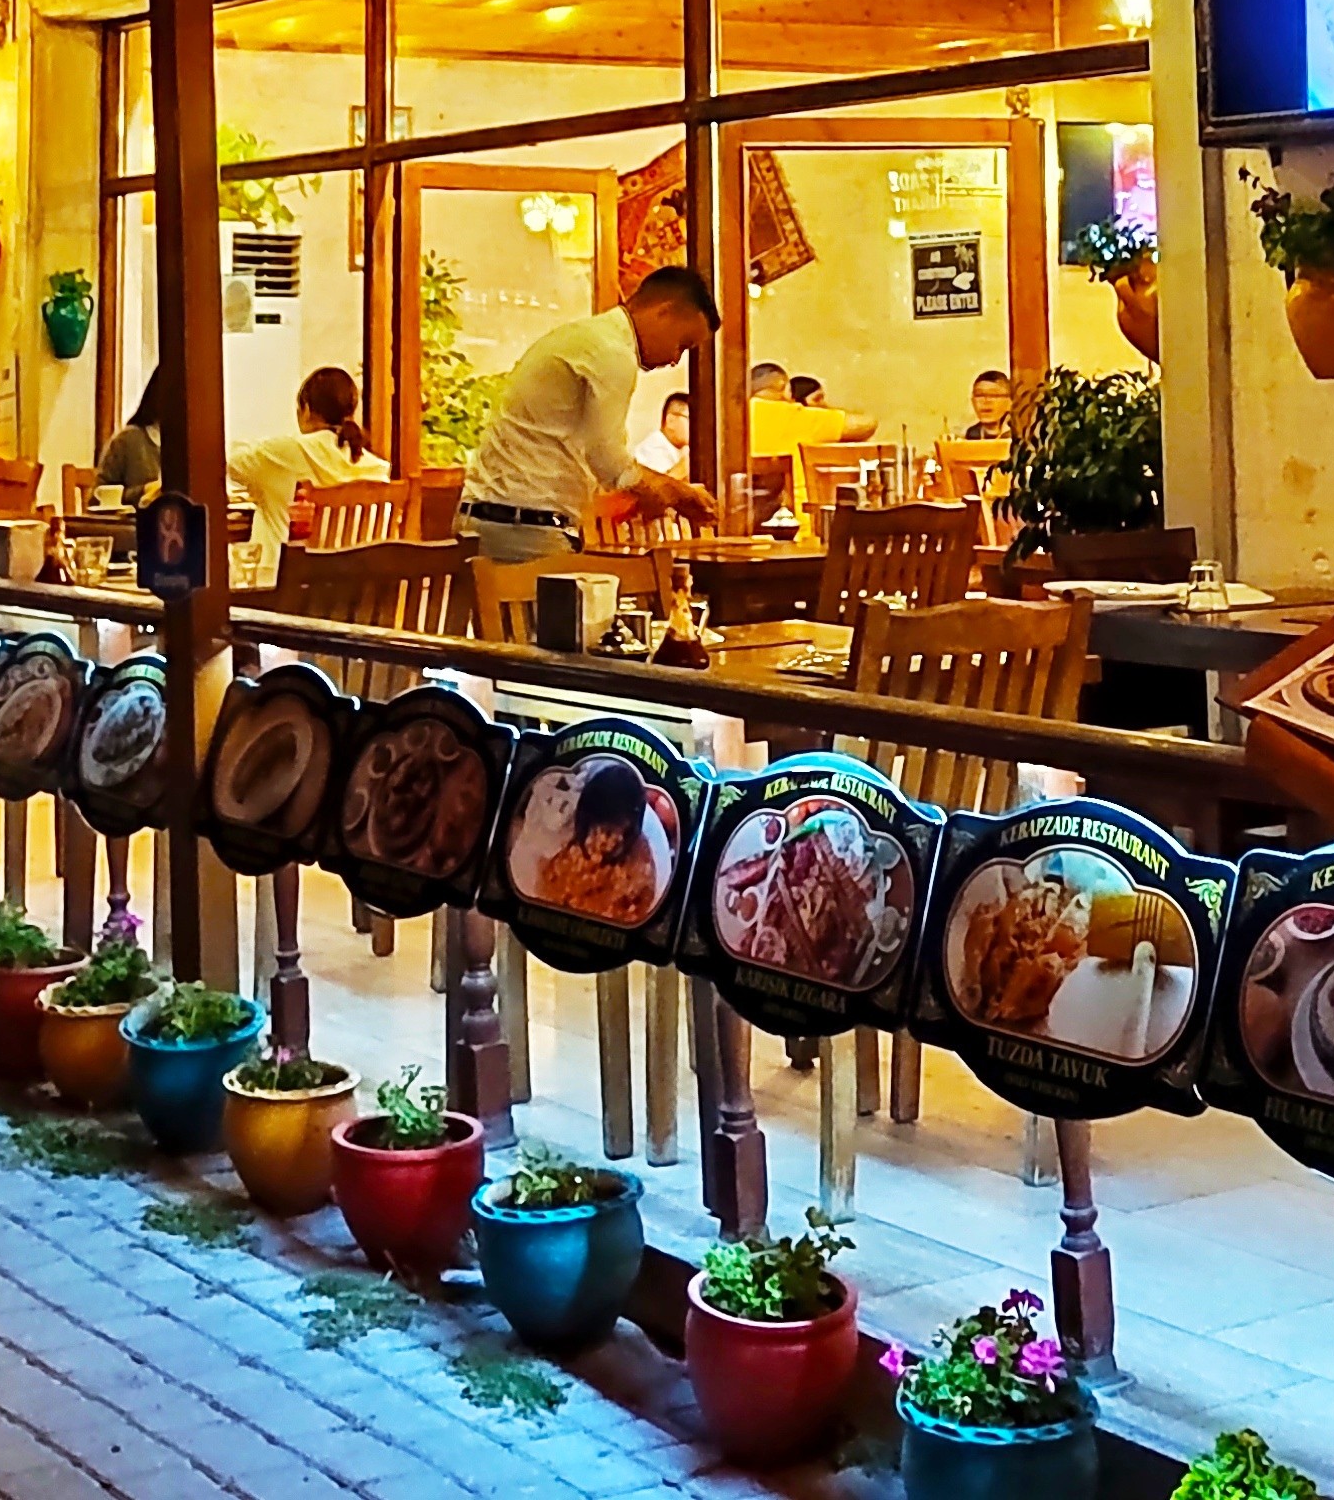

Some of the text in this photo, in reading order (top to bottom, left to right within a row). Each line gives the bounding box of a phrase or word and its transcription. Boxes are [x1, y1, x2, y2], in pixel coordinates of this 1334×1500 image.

[829, 772, 898, 824] RESTAURANT
[999, 815, 1171, 882] KEBAPZADE RESTAURANT
[986, 1034, 1045, 1072] TUZDA
[1048, 1052, 1112, 1090] TAVUK
